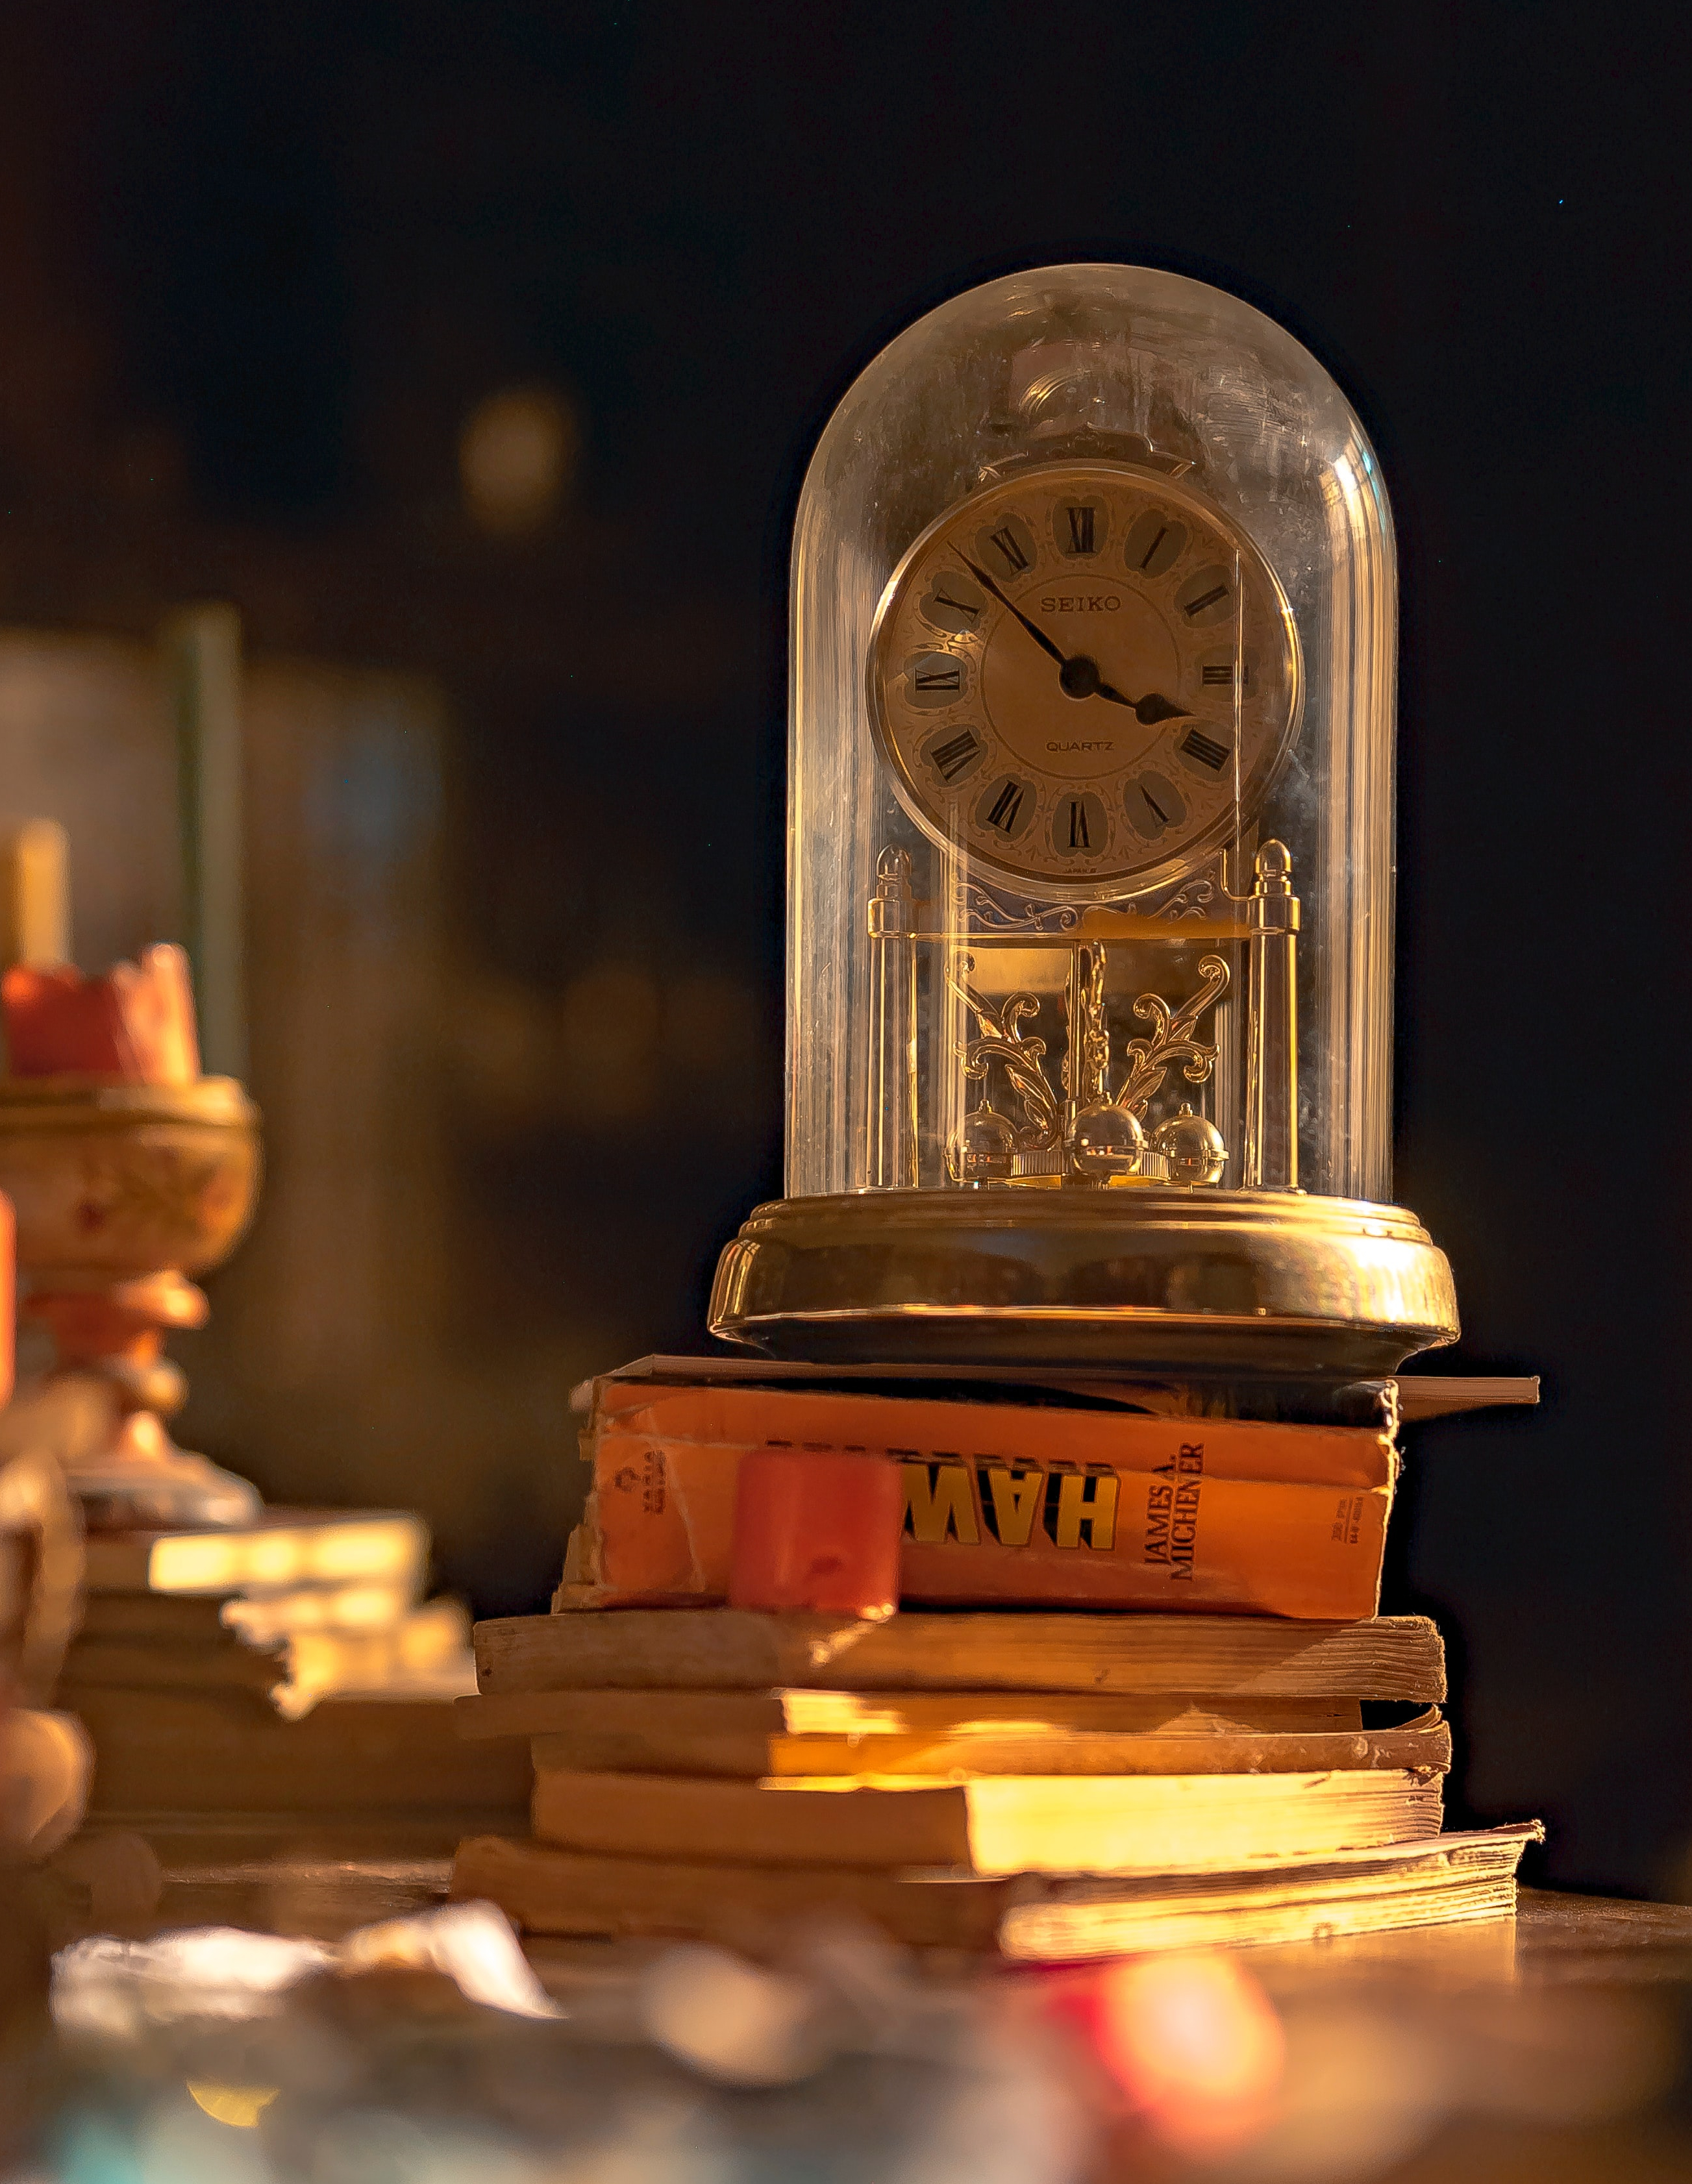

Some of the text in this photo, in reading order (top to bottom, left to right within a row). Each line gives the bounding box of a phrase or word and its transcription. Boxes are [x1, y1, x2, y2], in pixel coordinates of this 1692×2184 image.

[1040, 595, 1121, 612] SEIKO
[1045, 740, 1114, 752] QUARTZ
[901, 1456, 1119, 1551] HAW
[1143, 1485, 1173, 1566] JAMES
[1169, 1441, 1204, 1582] MICHENER
